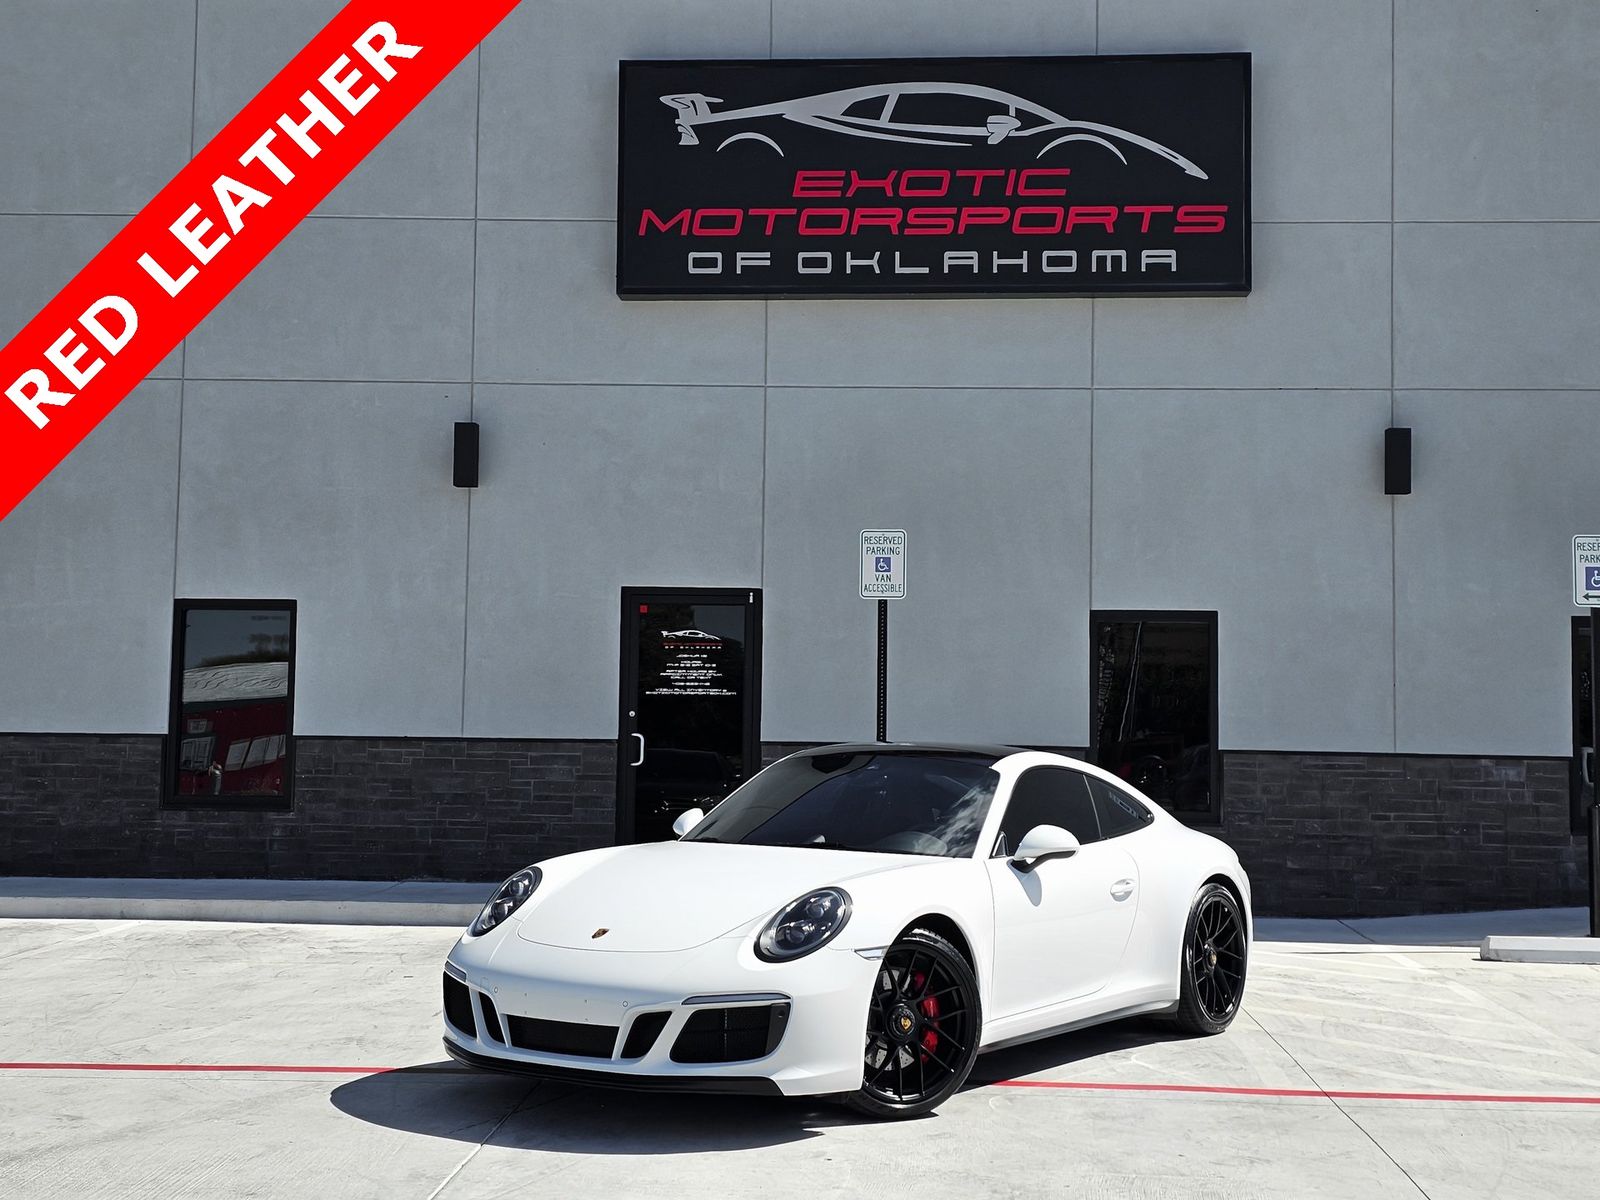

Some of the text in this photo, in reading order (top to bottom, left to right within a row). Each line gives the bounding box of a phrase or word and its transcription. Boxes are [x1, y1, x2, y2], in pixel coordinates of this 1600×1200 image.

[792, 168, 1071, 198] EXOTIC
[638, 205, 1229, 237] MOTORSPORTS
[687, 249, 1178, 275] OF OKLAHOMA
[863, 536, 903, 545] RESERVED
[866, 546, 901, 555] PARKING
[874, 574, 892, 582] VAN
[863, 583, 902, 593] ACCESSIBLE
